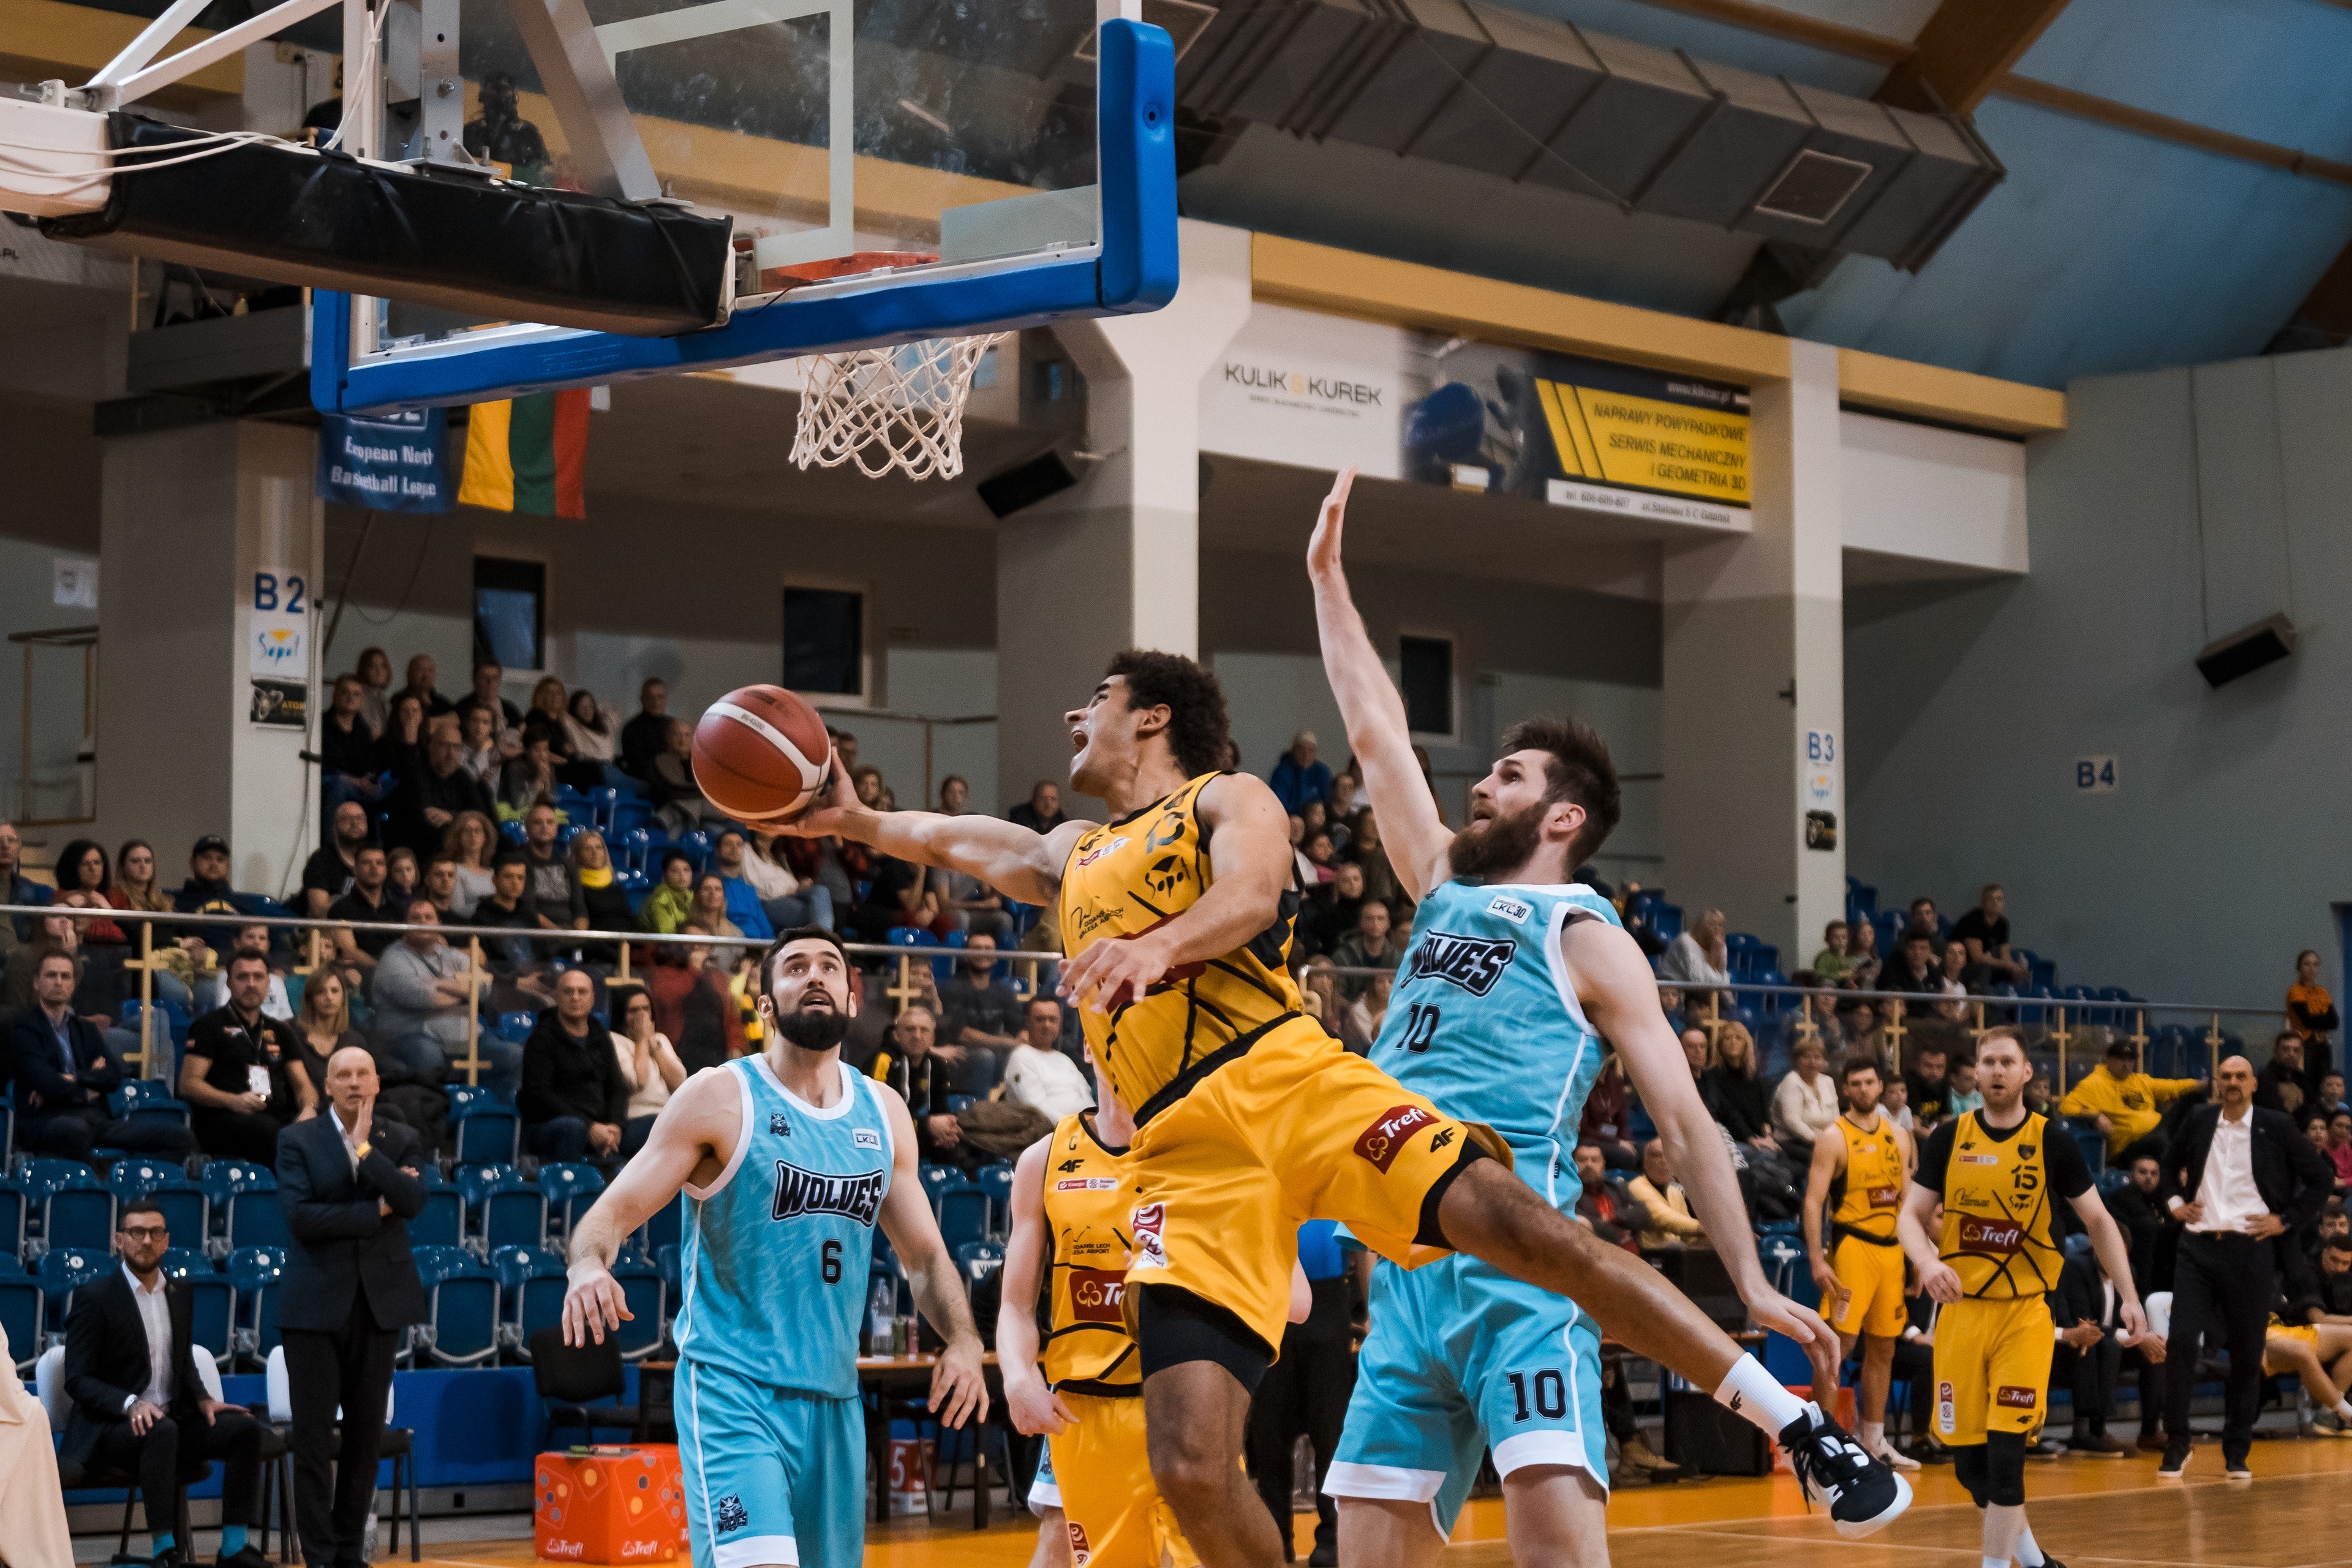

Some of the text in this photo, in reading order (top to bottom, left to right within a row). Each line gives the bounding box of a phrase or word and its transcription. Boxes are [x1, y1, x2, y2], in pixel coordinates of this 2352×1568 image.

[1226, 362, 1287, 391] KULIK
[1309, 376, 1382, 406] KUREK
[1594, 402, 1746, 442] NAPRAWY POWYPADKOWE
[1609, 432, 1746, 469] SERWIS MECHANICZNY
[1657, 464, 1728, 488] GEOMETRIA
[1732, 475, 1746, 491] 3D
[258, 632, 300, 666] Sopot
[1808, 731, 1834, 762] B3
[2077, 759, 2115, 788] B4
[1145, 855, 1191, 900] Sopot
[1402, 930, 1516, 997] WOLVES
[1393, 1001, 1442, 1055] 10
[1379, 1107, 1428, 1139] Trefl
[1430, 1126, 1456, 1154] 4F
[1058, 1159, 1085, 1173] 4F
[2011, 1164, 2039, 1190] 15
[774, 1161, 884, 1227] WOLVES
[2008, 1194, 2035, 1213] Sopot
[1983, 1226, 2019, 1247] Trefl
[821, 1238, 843, 1286] 6
[1506, 1367, 1568, 1425] 10
[2011, 1390, 2035, 1404] Trefl
[891, 1446, 906, 1489] 5
